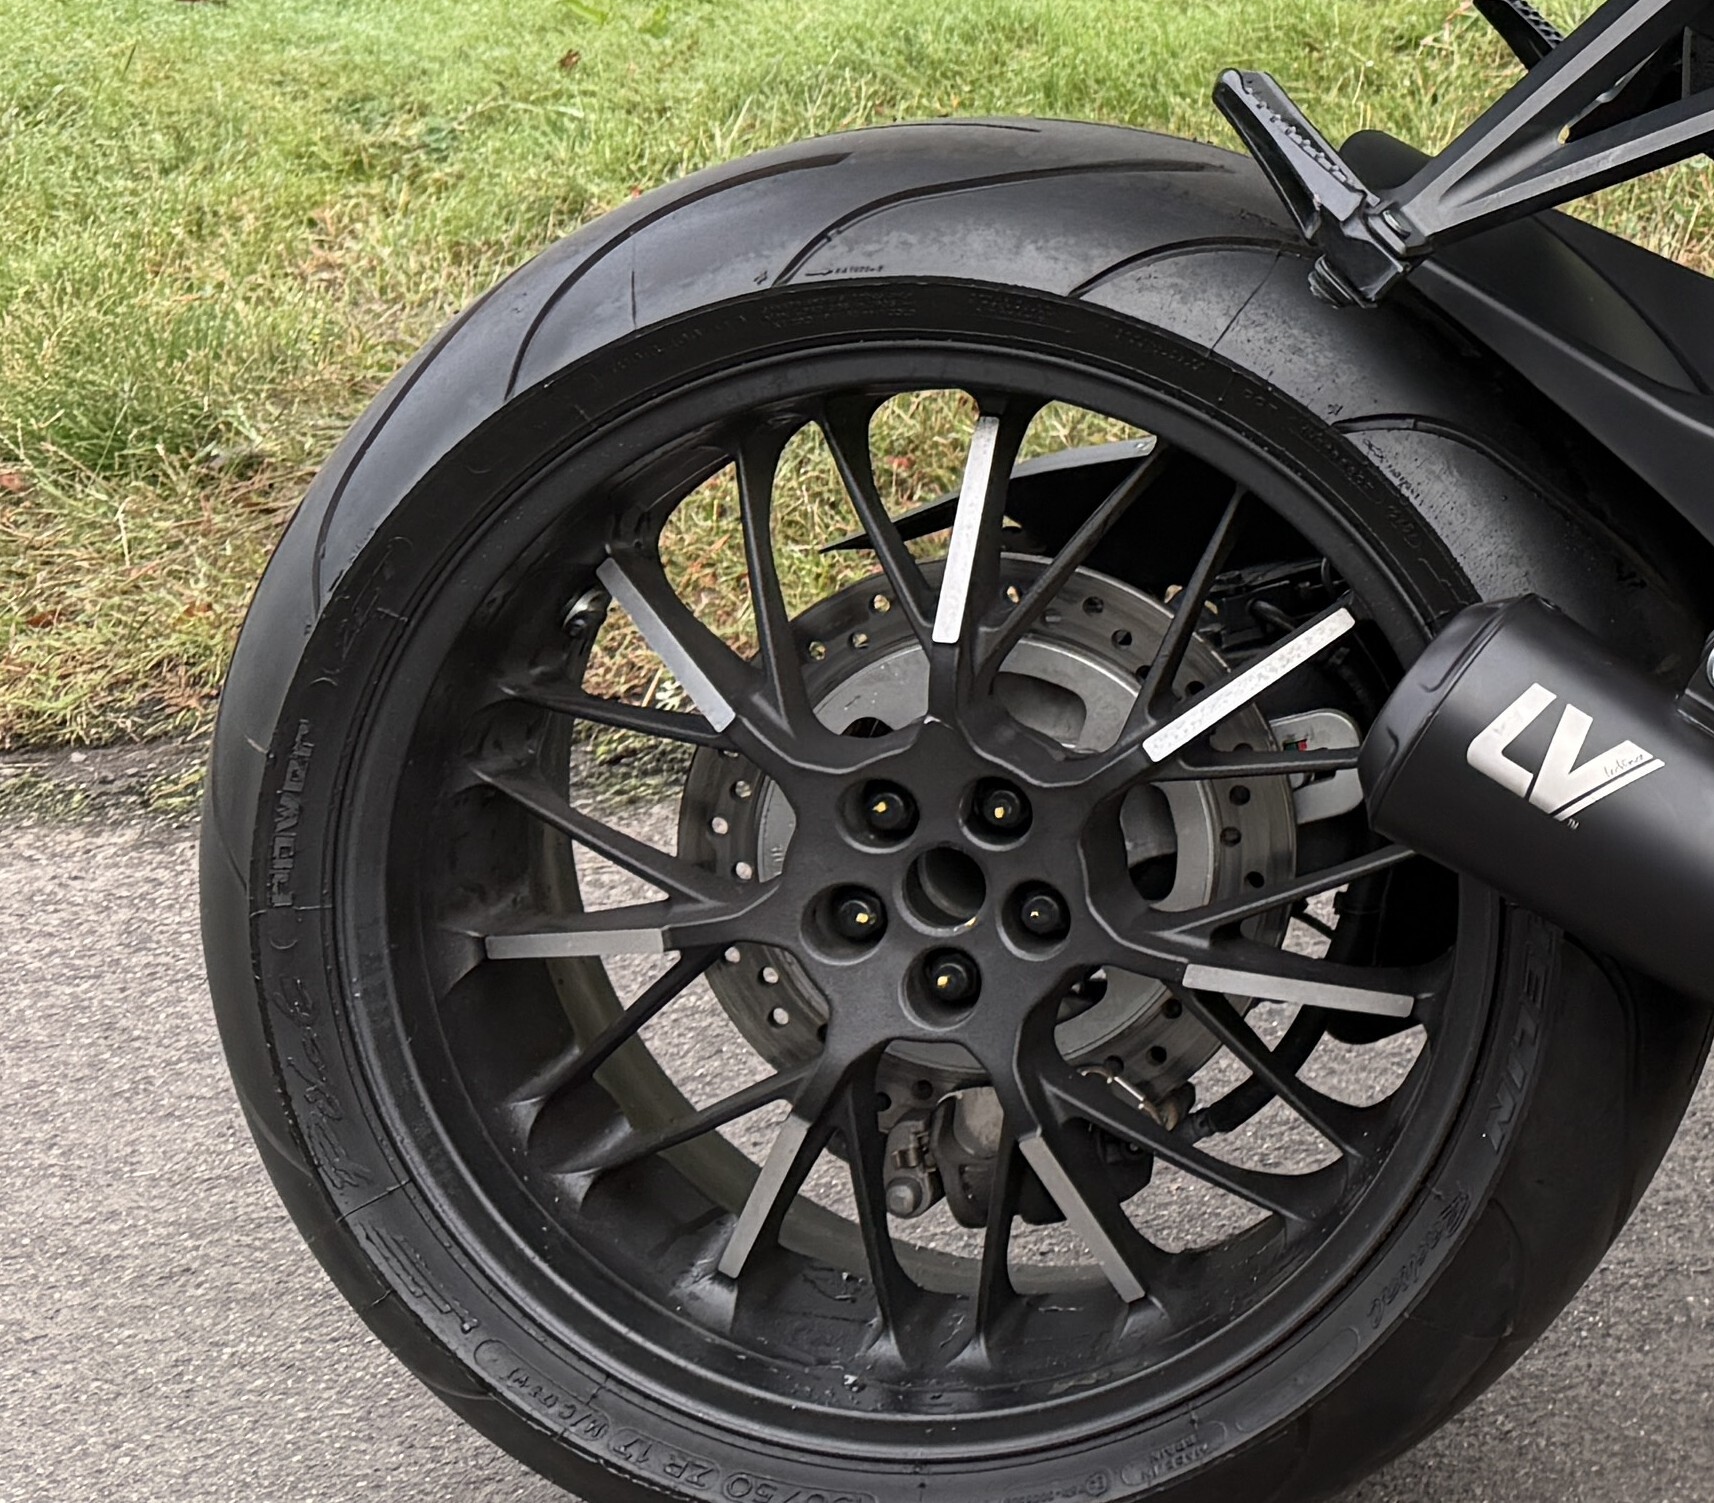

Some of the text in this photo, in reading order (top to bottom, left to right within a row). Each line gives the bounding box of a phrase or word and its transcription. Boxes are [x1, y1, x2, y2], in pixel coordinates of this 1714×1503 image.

[1467, 682, 1666, 821] LV
[554, 1400, 607, 1442] M/C
[610, 1430, 656, 1467] 17
[662, 1453, 714, 1489] ZR
